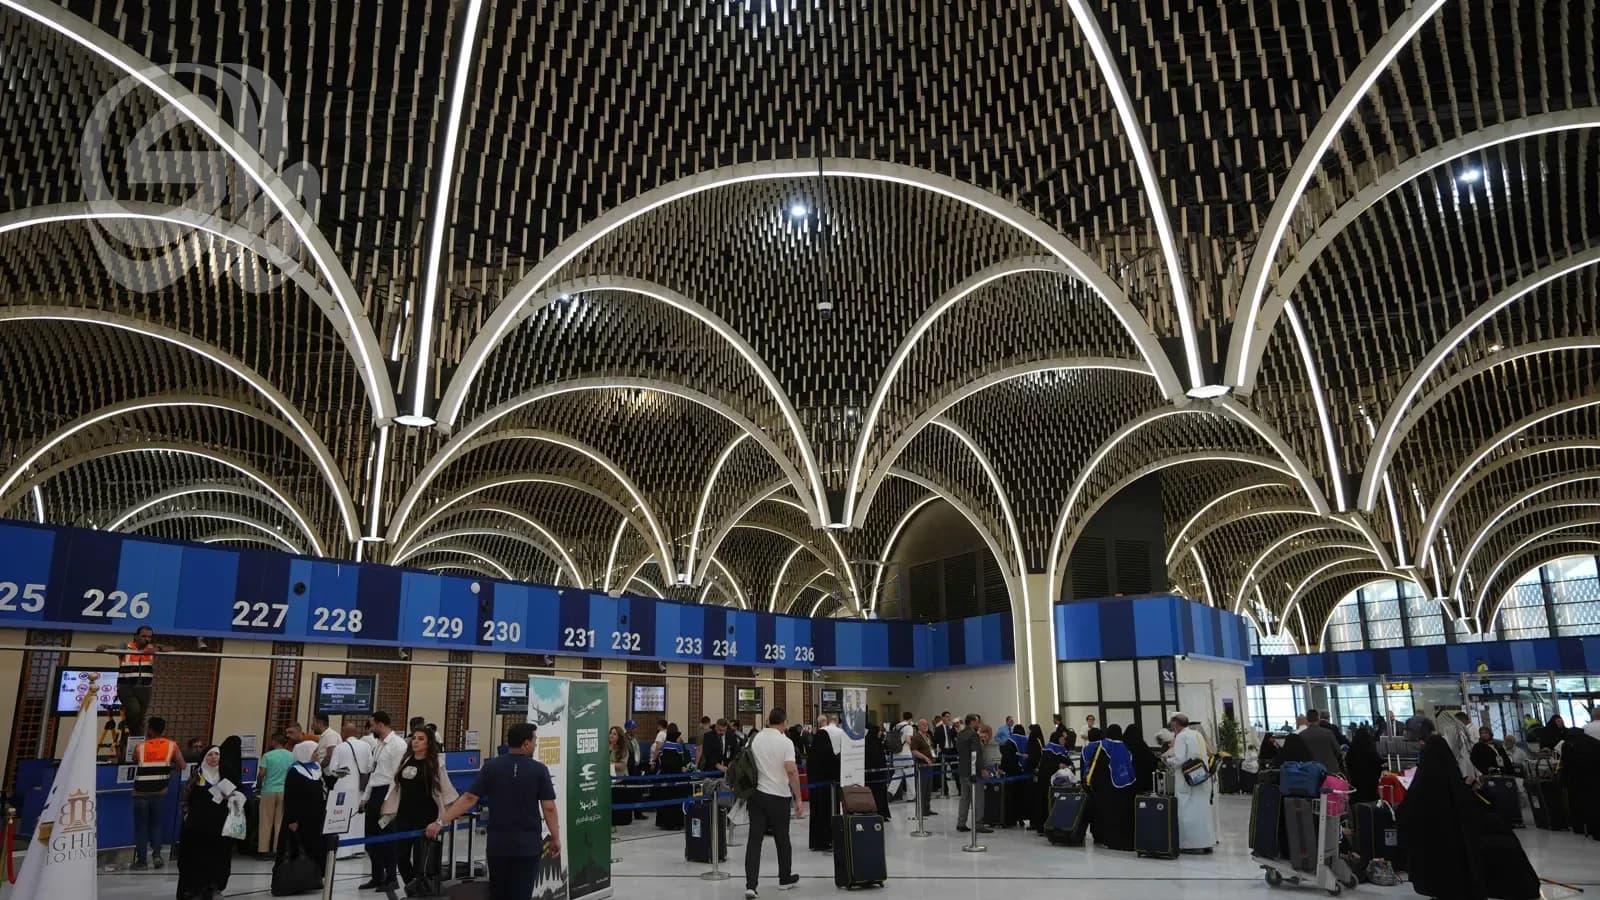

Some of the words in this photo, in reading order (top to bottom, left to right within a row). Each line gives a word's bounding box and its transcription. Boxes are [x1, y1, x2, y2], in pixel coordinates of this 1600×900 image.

[0, 581, 46, 612] 25
[82, 588, 150, 619] 226
[232, 600, 289, 628] 227
[313, 607, 363, 633] 228
[422, 615, 463, 639] 229
[483, 620, 521, 643] 230
[564, 627, 595, 648] 231
[611, 631, 641, 651] 232
[675, 636, 702, 655] 233
[713, 639, 738, 657] 234
[764, 643, 786, 660] 235
[794, 646, 815, 662] 236
